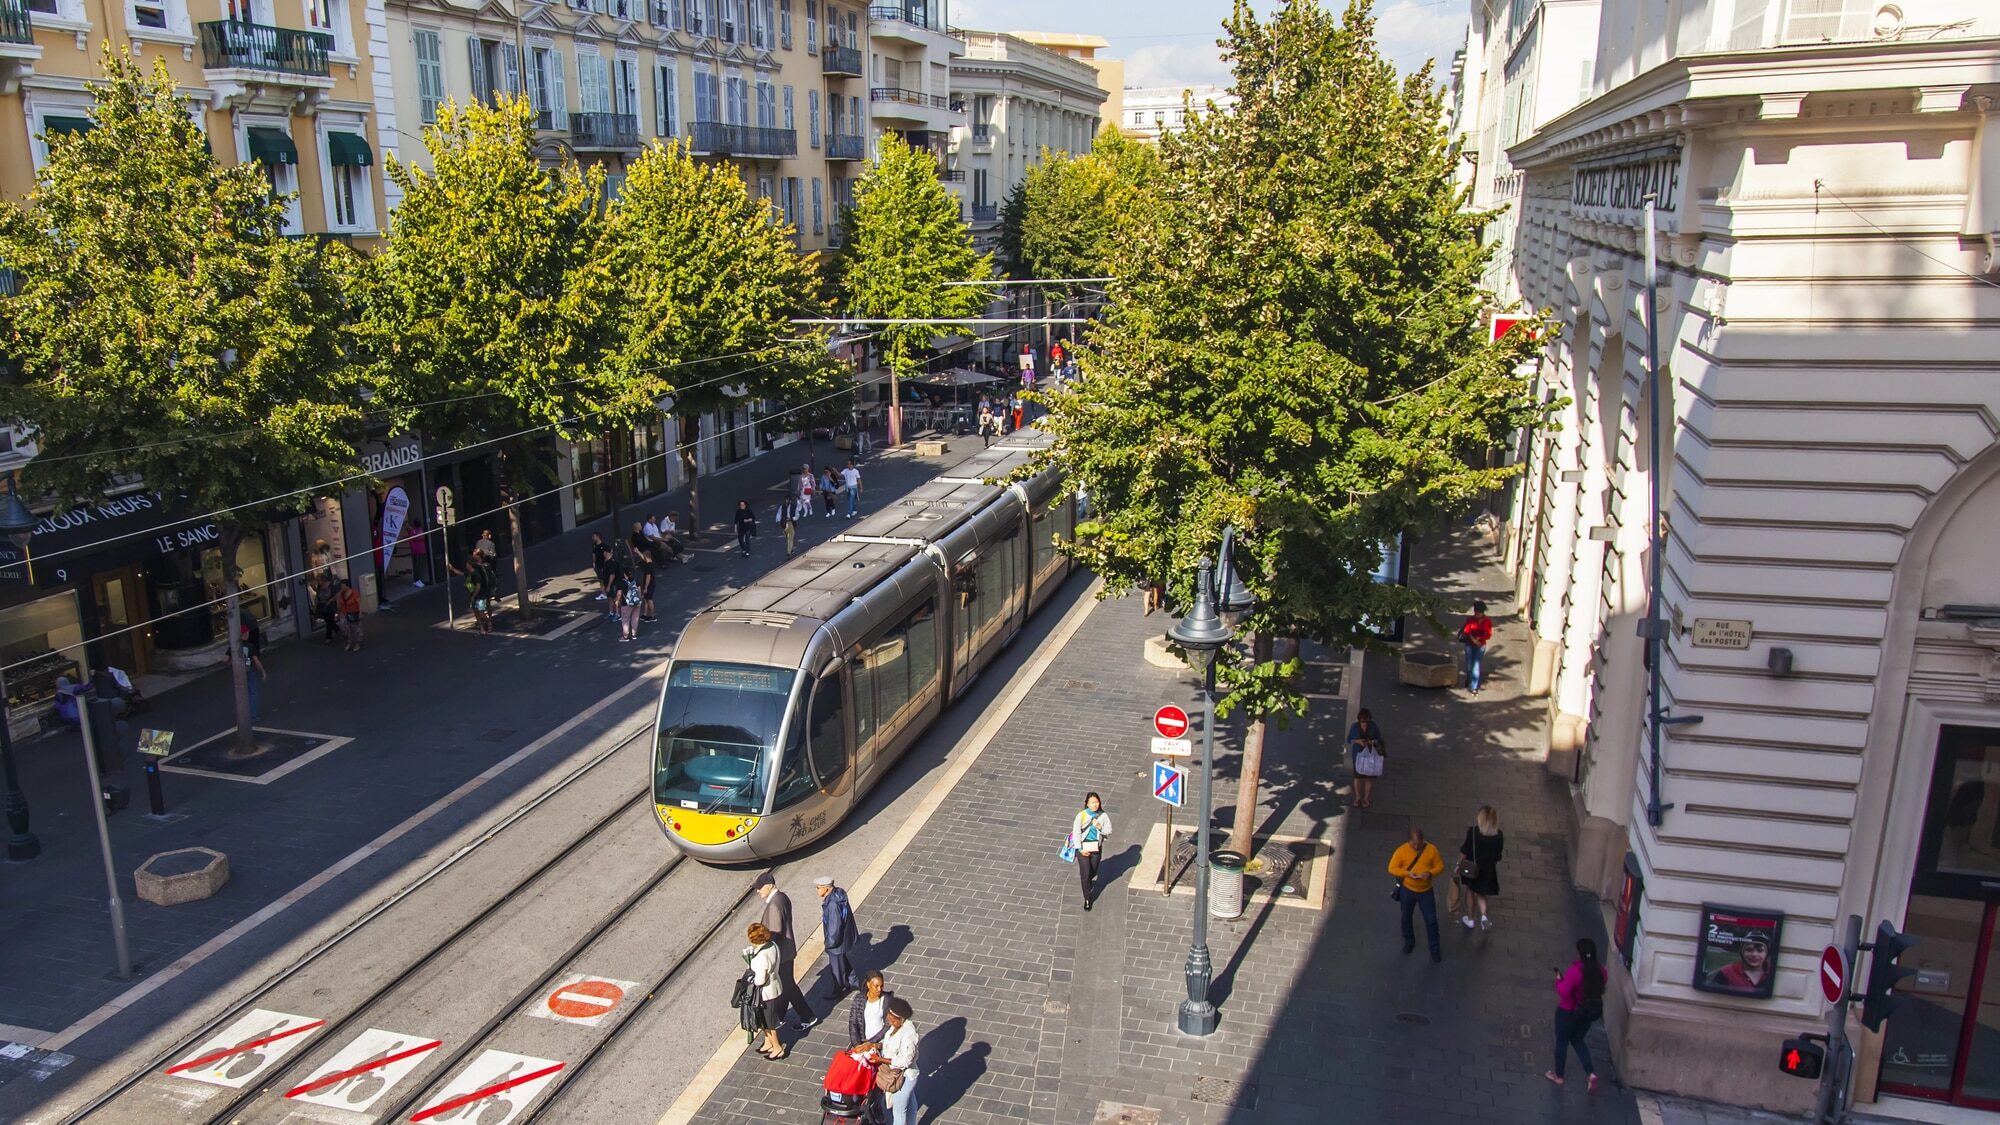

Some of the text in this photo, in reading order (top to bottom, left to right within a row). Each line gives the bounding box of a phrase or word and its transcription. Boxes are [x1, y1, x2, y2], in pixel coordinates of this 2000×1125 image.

[361, 444, 419, 473] BRANDS
[98, 494, 152, 519] NEUFS
[156, 524, 220, 553] LE SANC
[56, 569, 67, 582] 9
[1714, 638, 1741, 646] POSTES
[1708, 924, 1718, 934] 2
